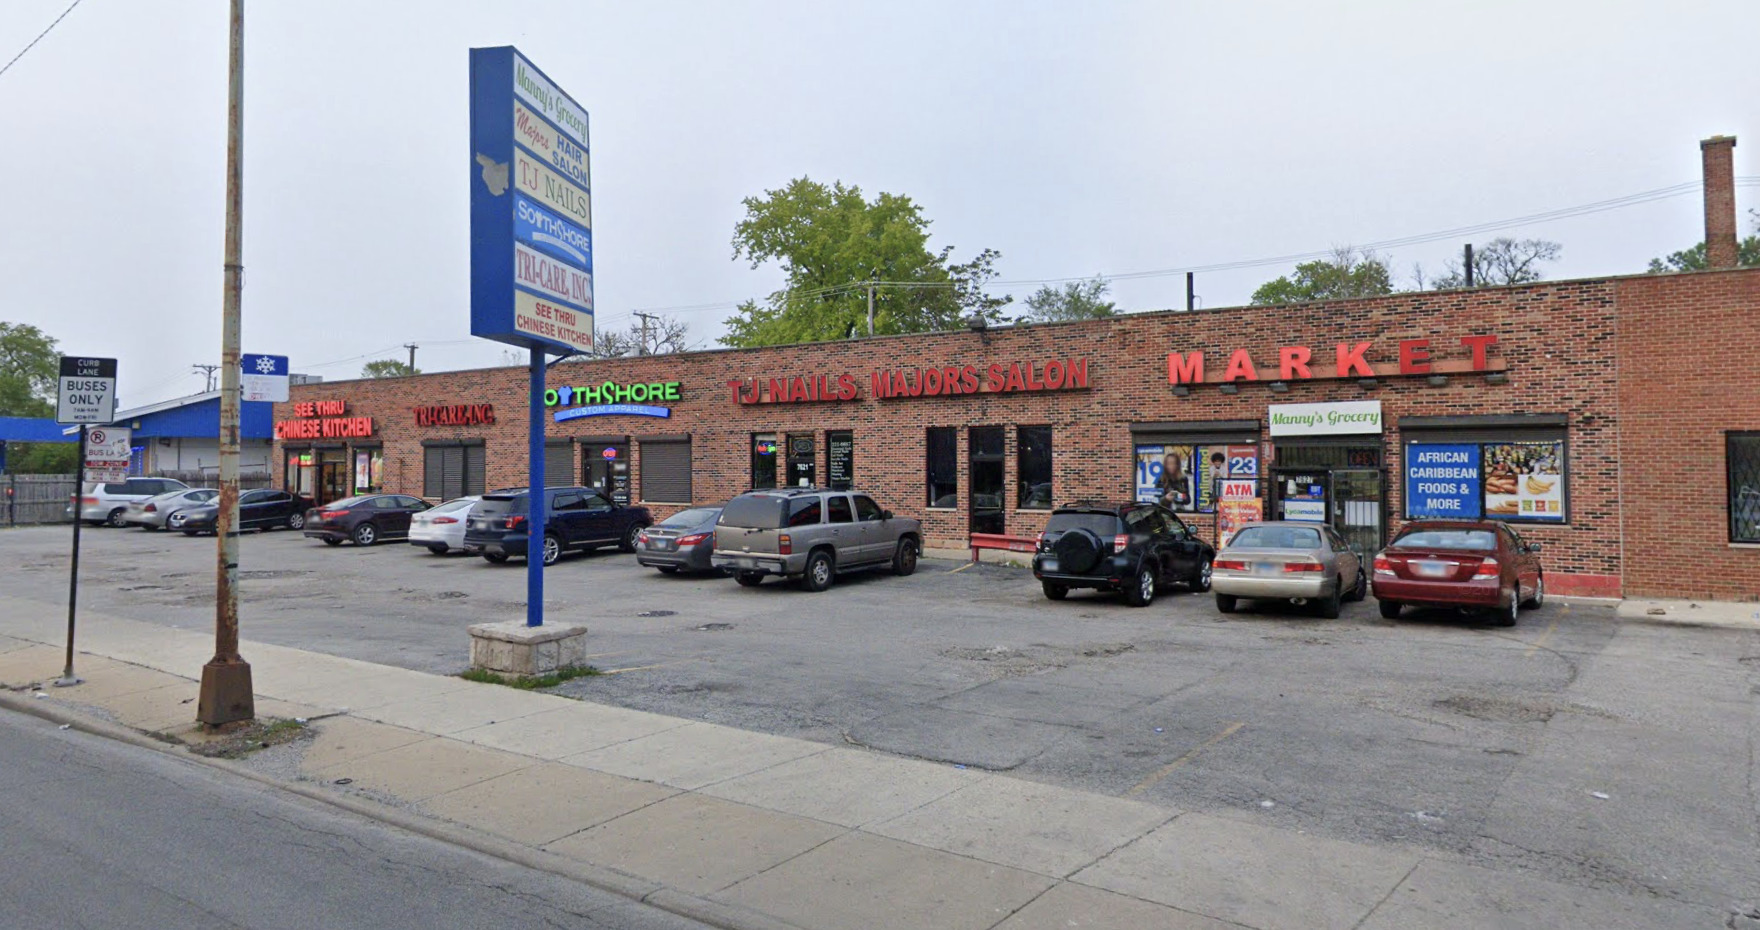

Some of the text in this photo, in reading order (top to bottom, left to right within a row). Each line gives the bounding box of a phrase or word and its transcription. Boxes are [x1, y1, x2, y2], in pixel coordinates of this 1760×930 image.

[517, 63, 587, 143] Manny's Grocery
[556, 135, 582, 165] HAIR
[552, 150, 587, 185] SALON
[519, 158, 587, 219] TJ NAILS
[516, 248, 570, 300] TRI-CARE,
[535, 302, 576, 327] SEE THRU
[516, 314, 592, 347] CHINESE KITCHEN
[77, 359, 100, 367] CURB
[1168, 335, 1497, 384] MARKET
[77, 368, 100, 376] LANE
[727, 357, 1088, 403] TJ NAILS MAJORS SALON
[67, 381, 107, 392] BUSES
[69, 394, 103, 405] ONLY
[294, 401, 345, 417] SEE THRU
[569, 404, 650, 417] CUSTOM APPAREL
[1271, 409, 1379, 427] Manny's Grocery
[275, 417, 372, 439] CHINESE KITCHEN
[1231, 457, 1256, 474] 23
[1418, 453, 1468, 463] AFRICAN
[1137, 461, 1164, 484] 19
[1199, 449, 1210, 506] Unlimited
[1411, 468, 1477, 479] CARIBBEAN
[1225, 484, 1252, 496] ATM
[1418, 484, 1469, 494] FOODS &
[1427, 499, 1461, 510] MORE
